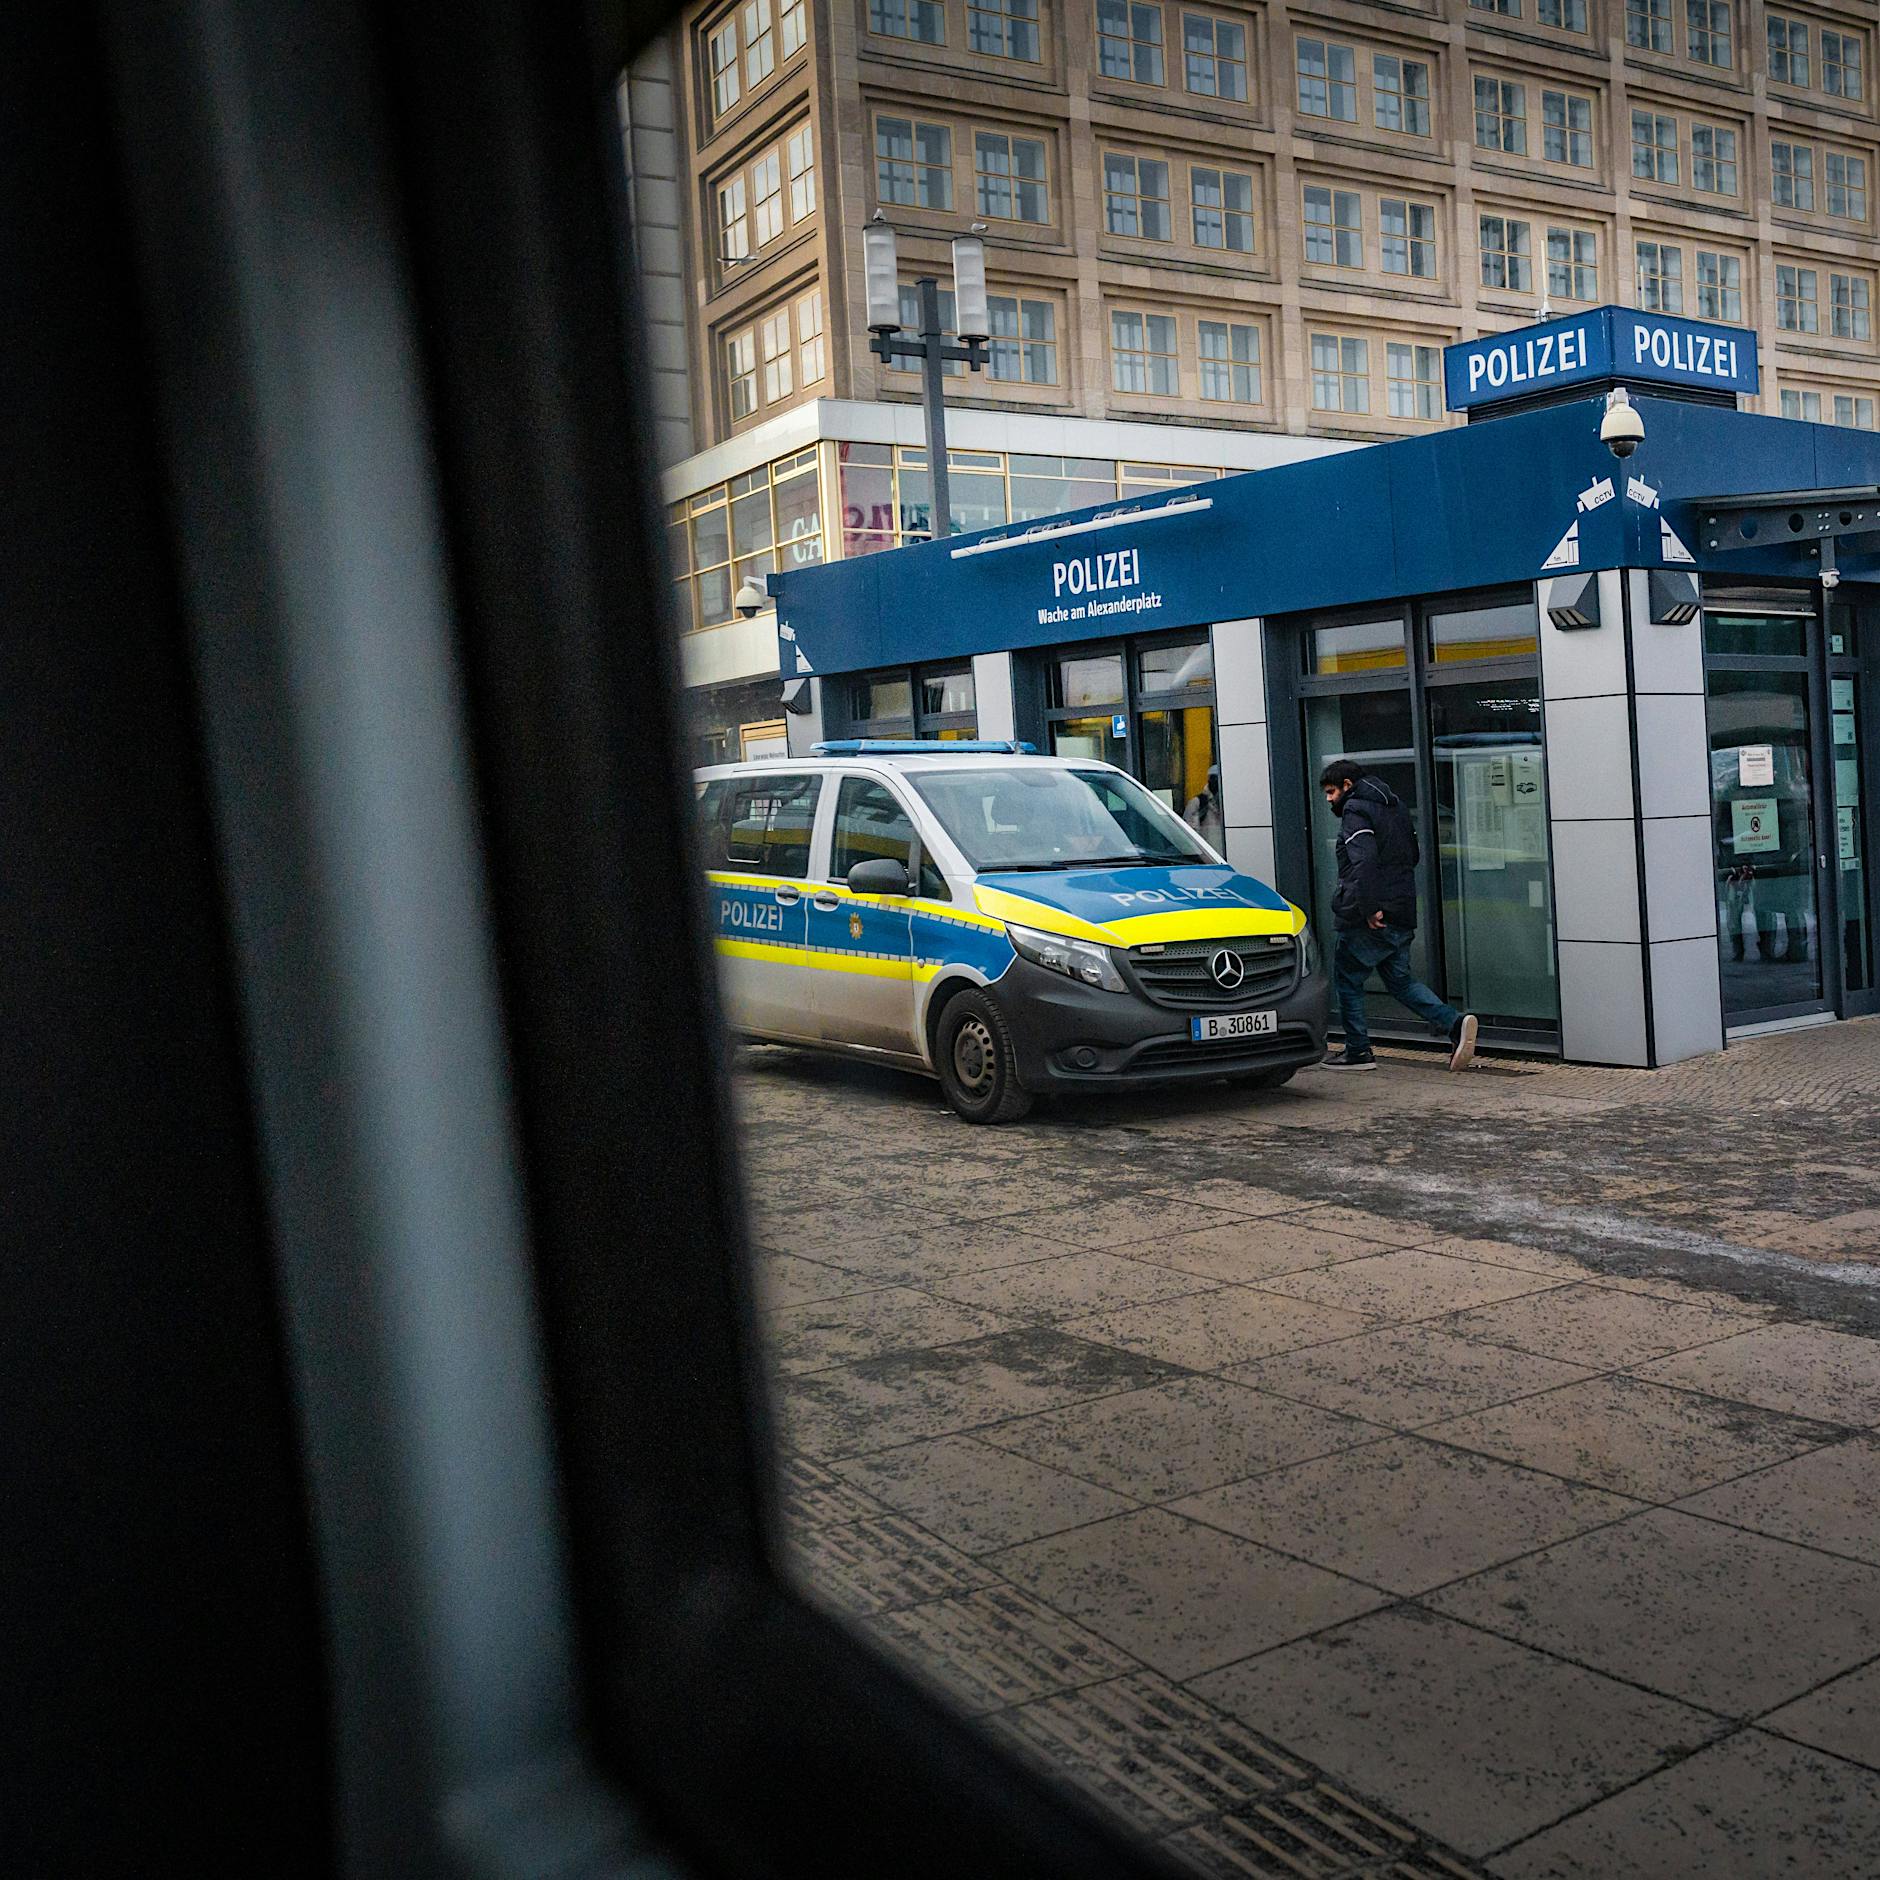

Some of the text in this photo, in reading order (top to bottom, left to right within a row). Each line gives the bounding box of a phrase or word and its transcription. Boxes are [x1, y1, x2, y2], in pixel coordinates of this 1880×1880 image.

[1468, 328, 1587, 392] POLIZEI
[1634, 325, 1737, 379] POLIZEI
[1594, 489, 1612, 504] CCTV
[1628, 488, 1645, 502] CCTV
[1053, 548, 1140, 597] POLIZEI
[1038, 592, 1162, 624] Wache am Alexanderplatz
[1110, 887, 1245, 907] POLIZEI
[720, 900, 783, 931] POLIZEI
[1208, 1014, 1270, 1037] B 30861
